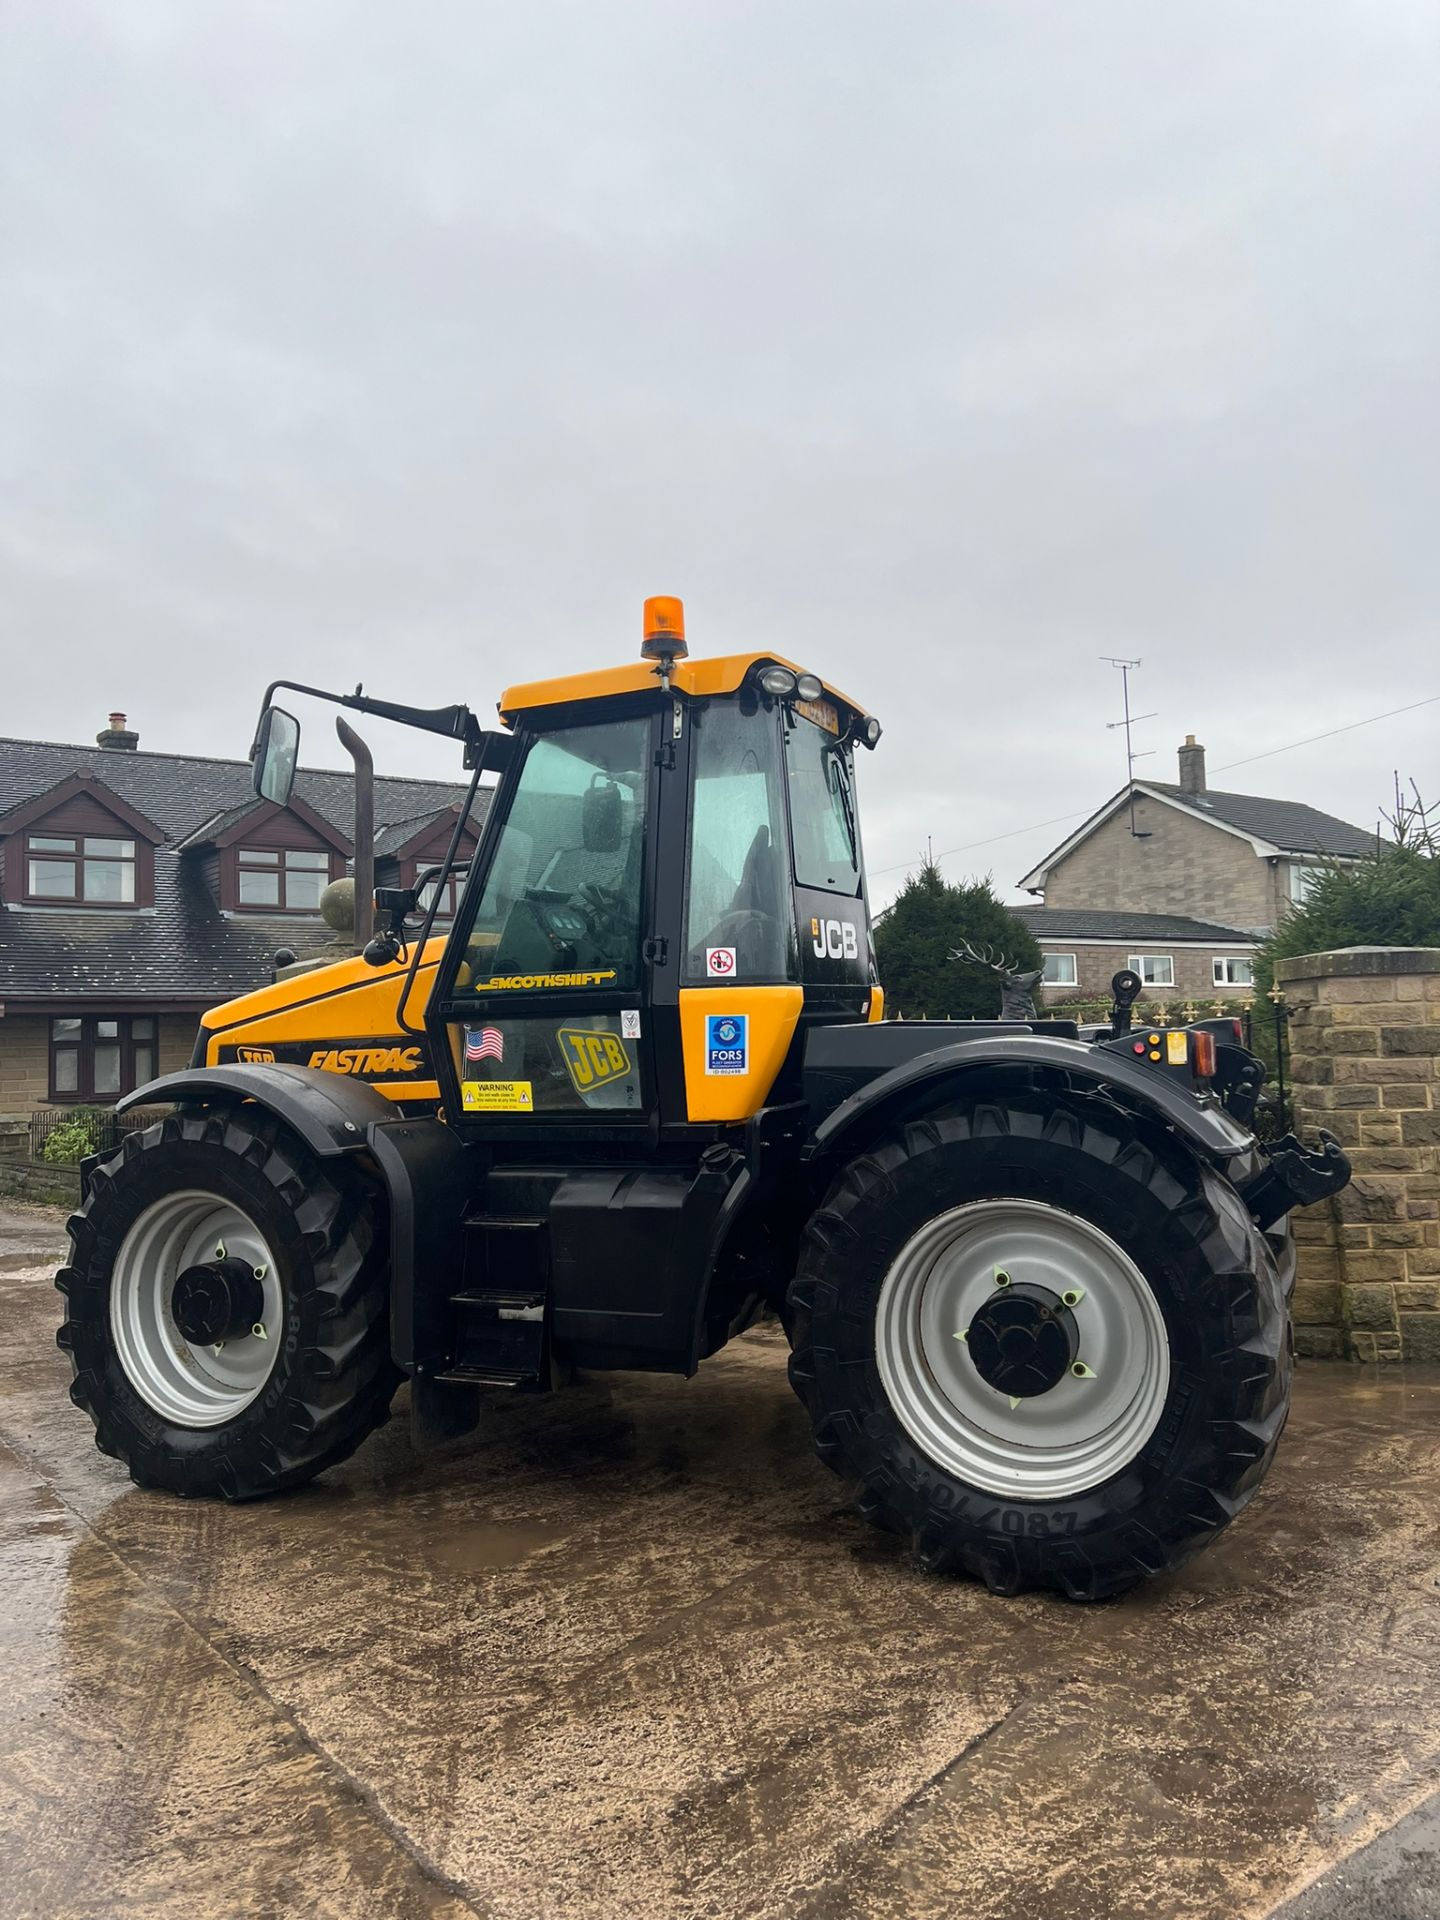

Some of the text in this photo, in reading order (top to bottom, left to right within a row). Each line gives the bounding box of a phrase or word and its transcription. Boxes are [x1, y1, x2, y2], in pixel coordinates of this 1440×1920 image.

[813, 918, 858, 960] JCB
[487, 971, 605, 990] SMOOTHSHIFT
[307, 1047, 424, 1075] FASTRAC
[568, 1035, 624, 1084] JCB
[712, 1050, 742, 1061] FORS
[478, 1083, 514, 1092] WARNING
